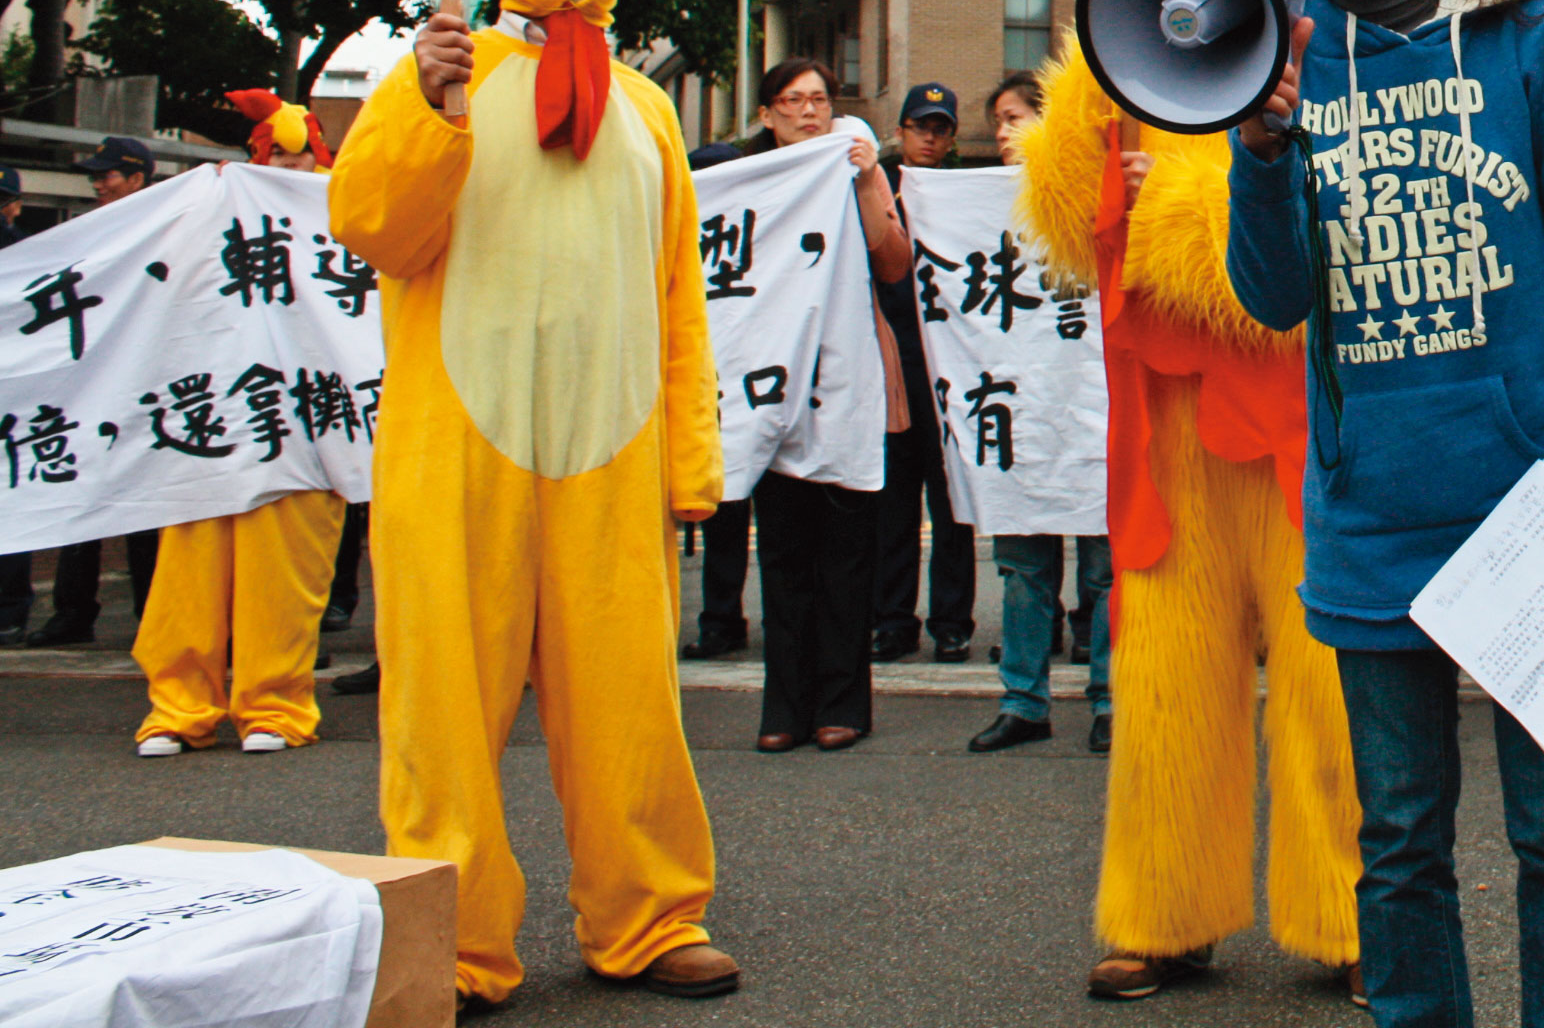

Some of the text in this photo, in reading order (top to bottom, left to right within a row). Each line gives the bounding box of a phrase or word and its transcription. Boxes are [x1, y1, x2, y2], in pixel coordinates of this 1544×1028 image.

[1301, 77, 1485, 137] HOLLYWOOD
[1304, 127, 1531, 213] TERS FURIST
[1319, 201, 1489, 266] NDIES
[1328, 245, 1515, 312] ATURAL
[1338, 328, 1488, 365] FUNDY GANGS
[716, 344, 822, 432] 口！
